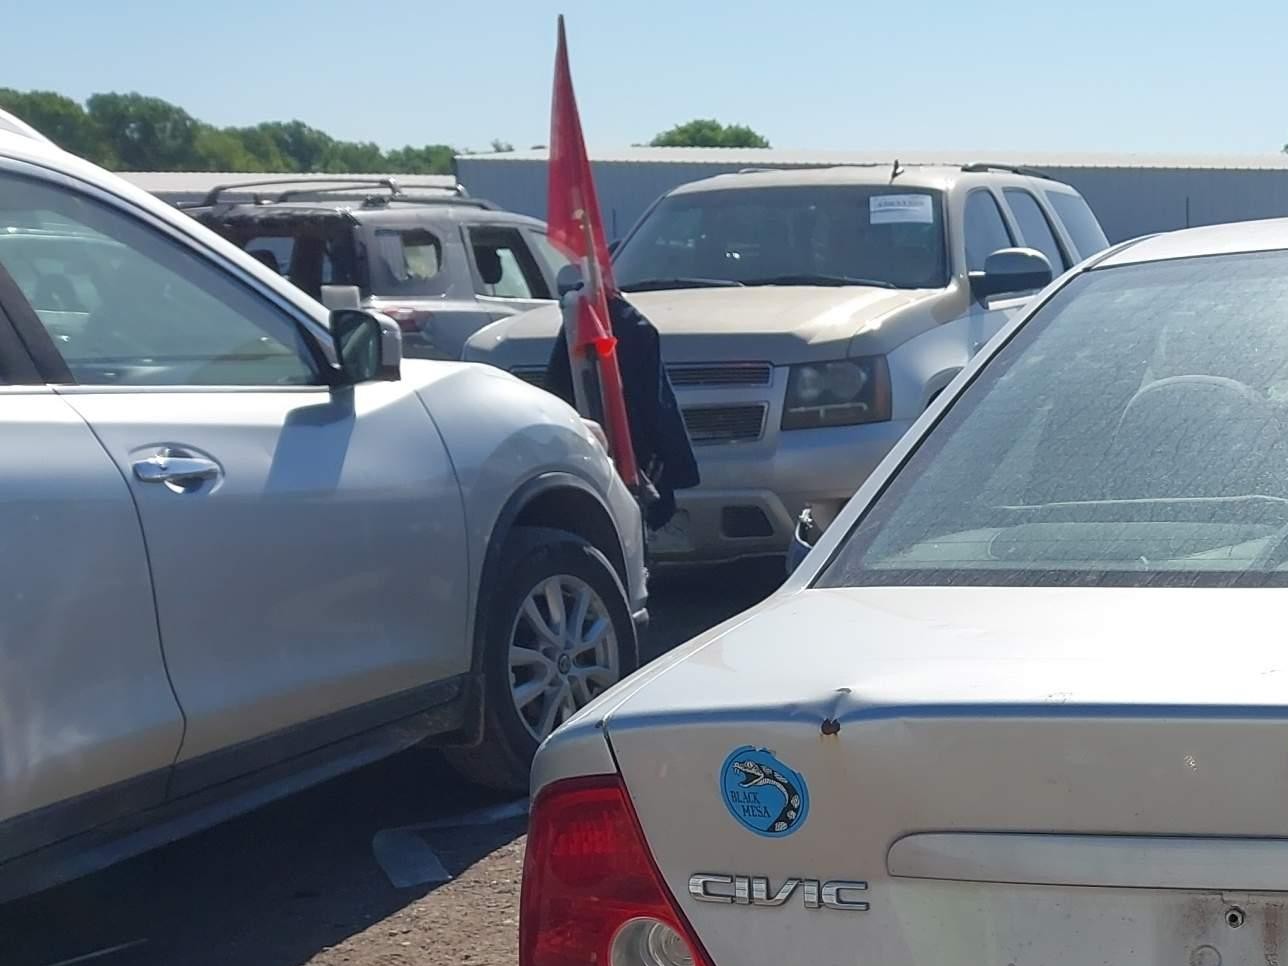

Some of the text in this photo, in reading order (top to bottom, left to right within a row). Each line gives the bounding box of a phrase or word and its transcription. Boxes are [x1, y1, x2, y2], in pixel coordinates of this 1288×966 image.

[730, 790, 760, 804] BLACK
[741, 805, 771, 818] MESA
[688, 873, 870, 911] CIVIC
